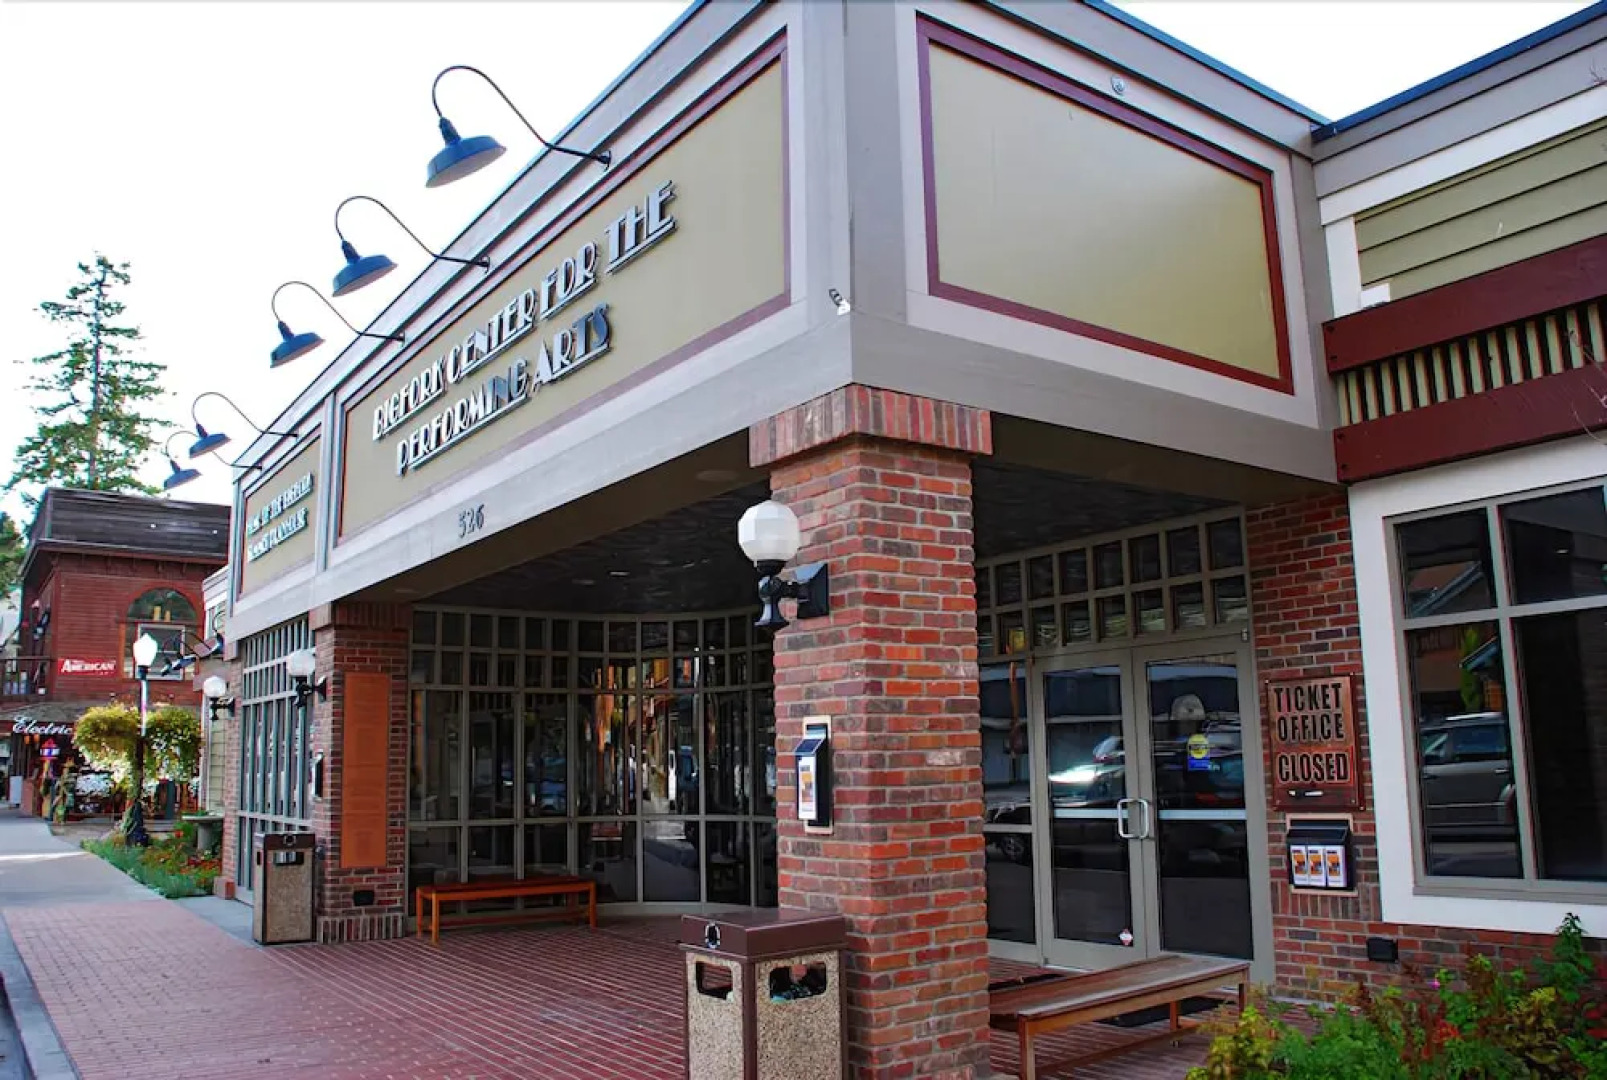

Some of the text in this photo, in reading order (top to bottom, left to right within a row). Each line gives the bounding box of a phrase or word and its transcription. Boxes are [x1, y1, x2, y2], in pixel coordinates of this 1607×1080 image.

[372, 179, 677, 441] BIGFORK CENTER FOR THE
[396, 302, 612, 476] PERFORMING ARTS
[458, 503, 485, 539] 526
[1273, 682, 1342, 713] TICKET
[1277, 713, 1344, 741] OFFICE
[1278, 753, 1349, 782] CLOSED
